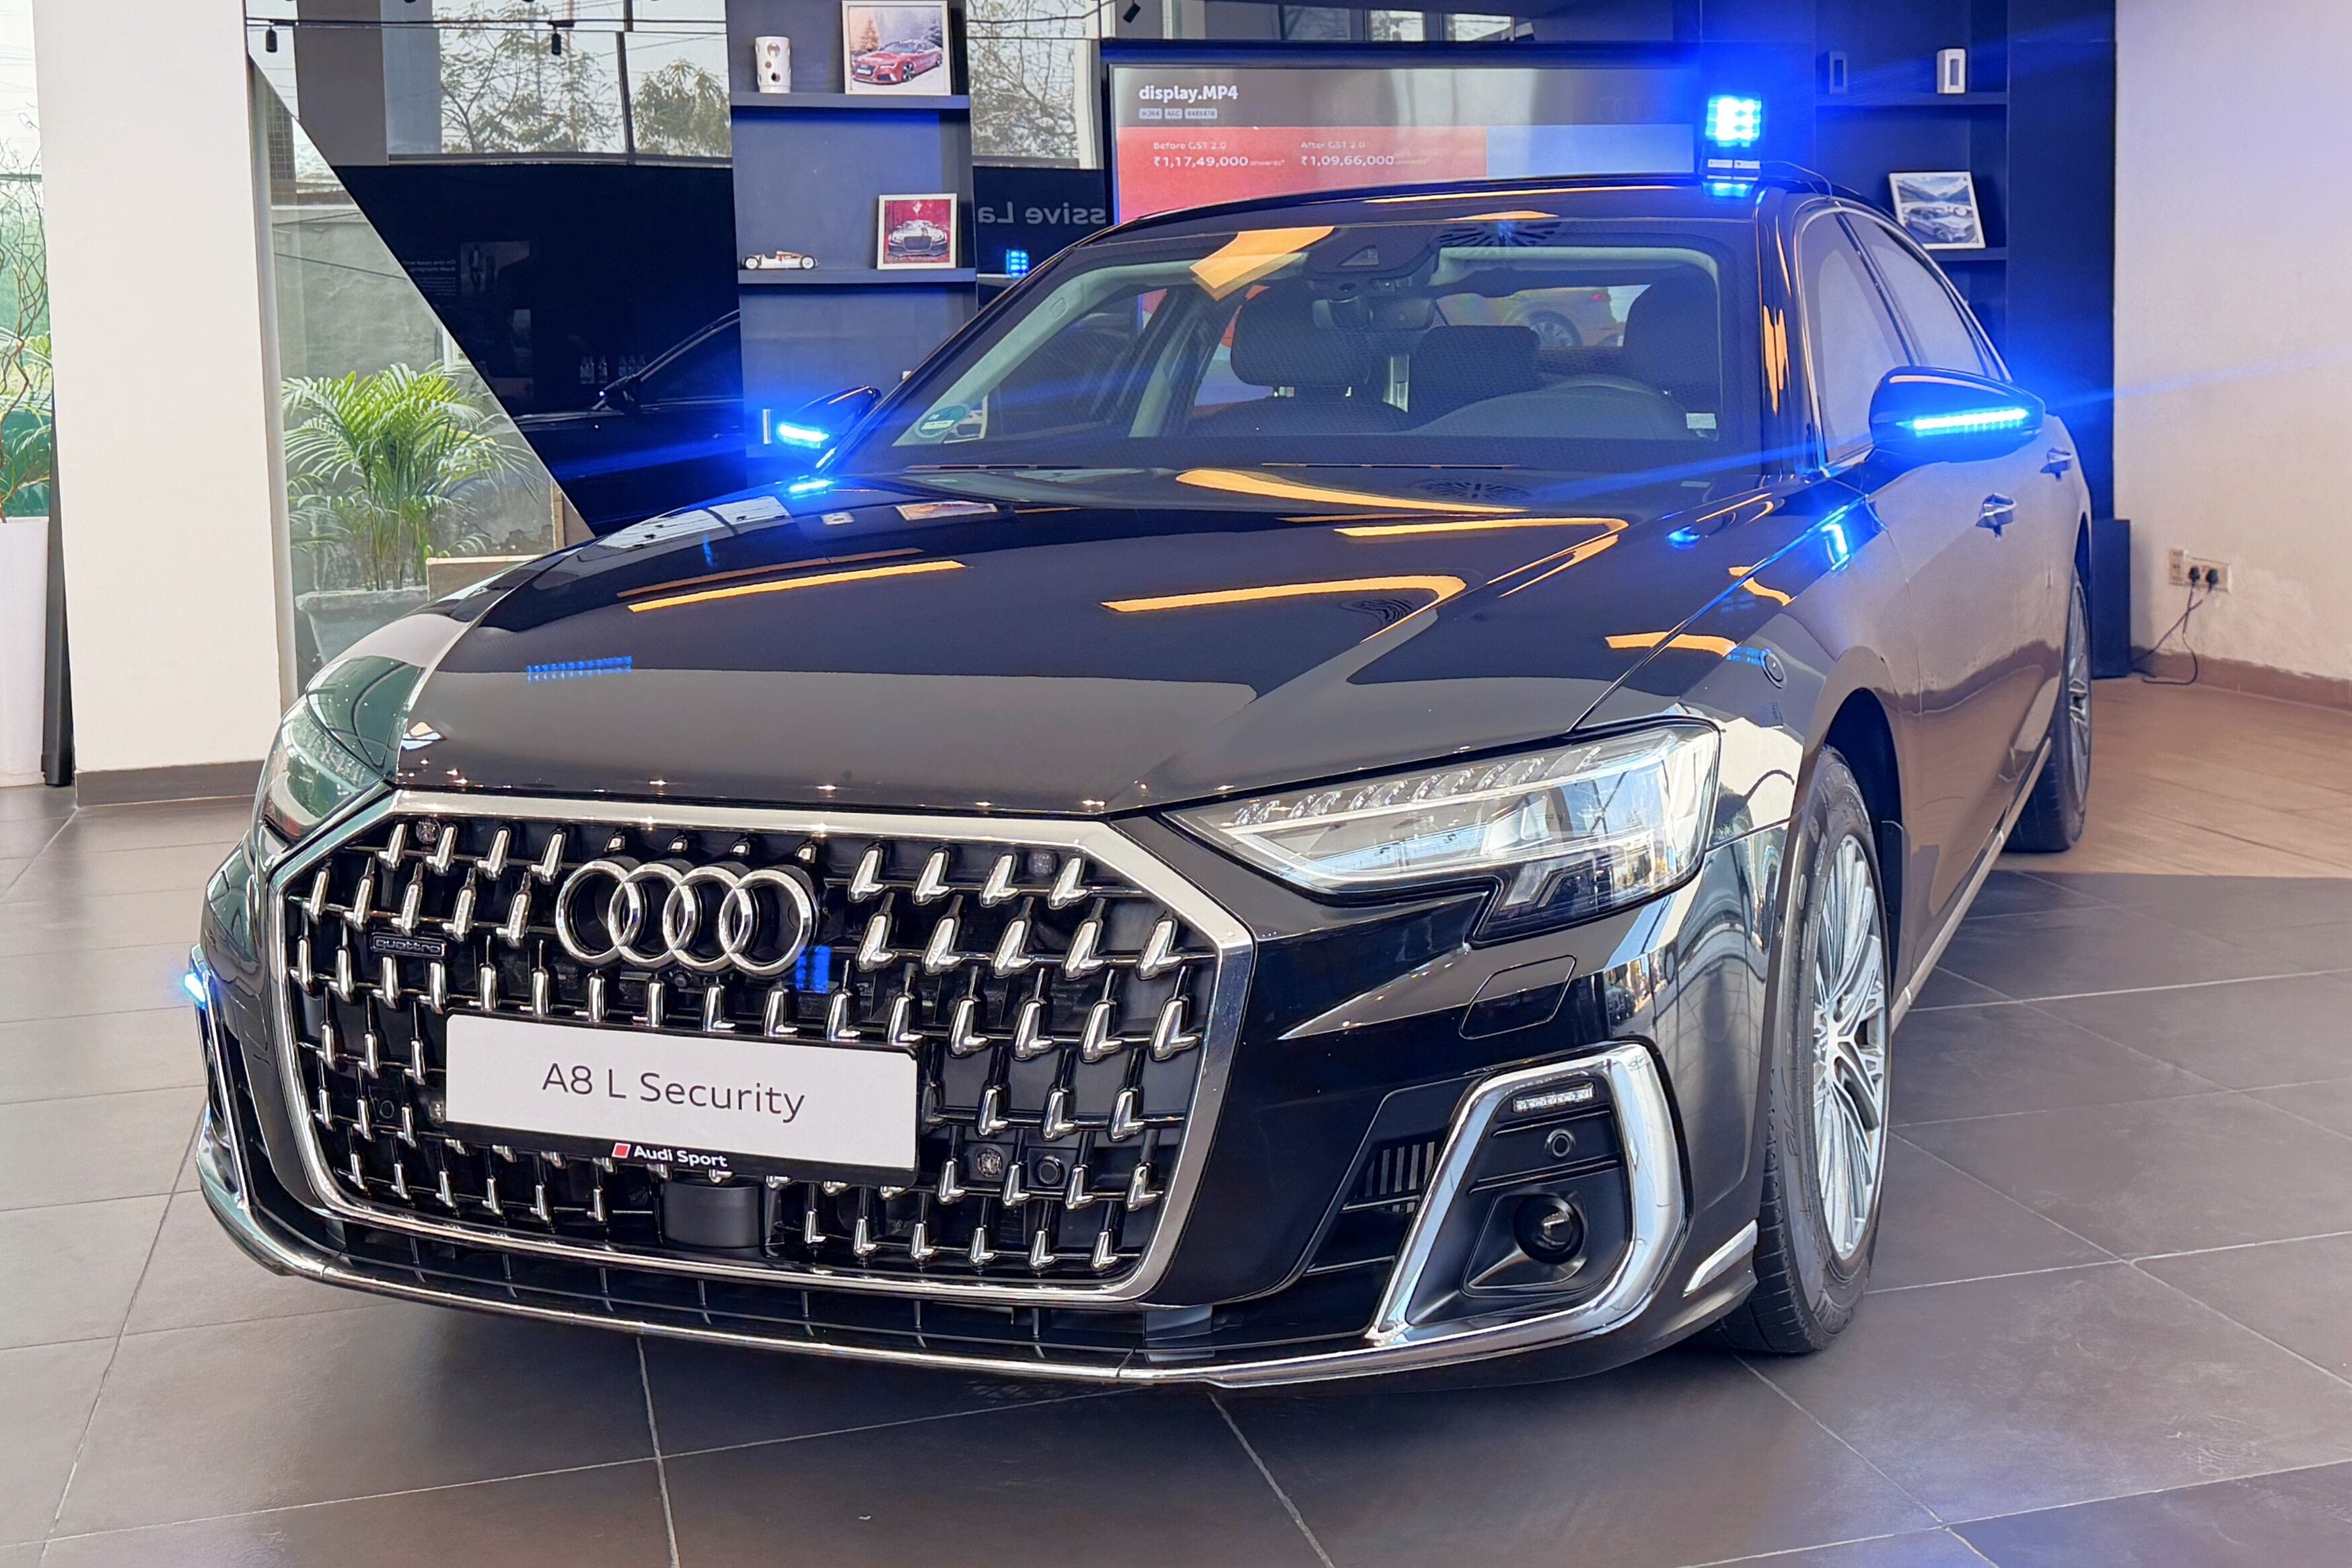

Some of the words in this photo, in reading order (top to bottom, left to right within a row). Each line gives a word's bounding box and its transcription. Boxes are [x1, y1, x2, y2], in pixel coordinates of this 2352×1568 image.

[1139, 85, 1238, 103] display.MP4
[1153, 141, 1185, 150] Before
[1188, 141, 1207, 150] GST
[1211, 141, 1227, 150] 2.0
[1301, 141, 1326, 149] After
[1328, 141, 1347, 149] GST
[1350, 141, 1365, 149] 2.0
[376, 939, 440, 952] quattro
[542, 1062, 594, 1094] A8
[608, 1069, 627, 1098] L
[640, 1071, 806, 1123] Security
[633, 1144, 672, 1163] Audi
[677, 1149, 728, 1168] Sport
